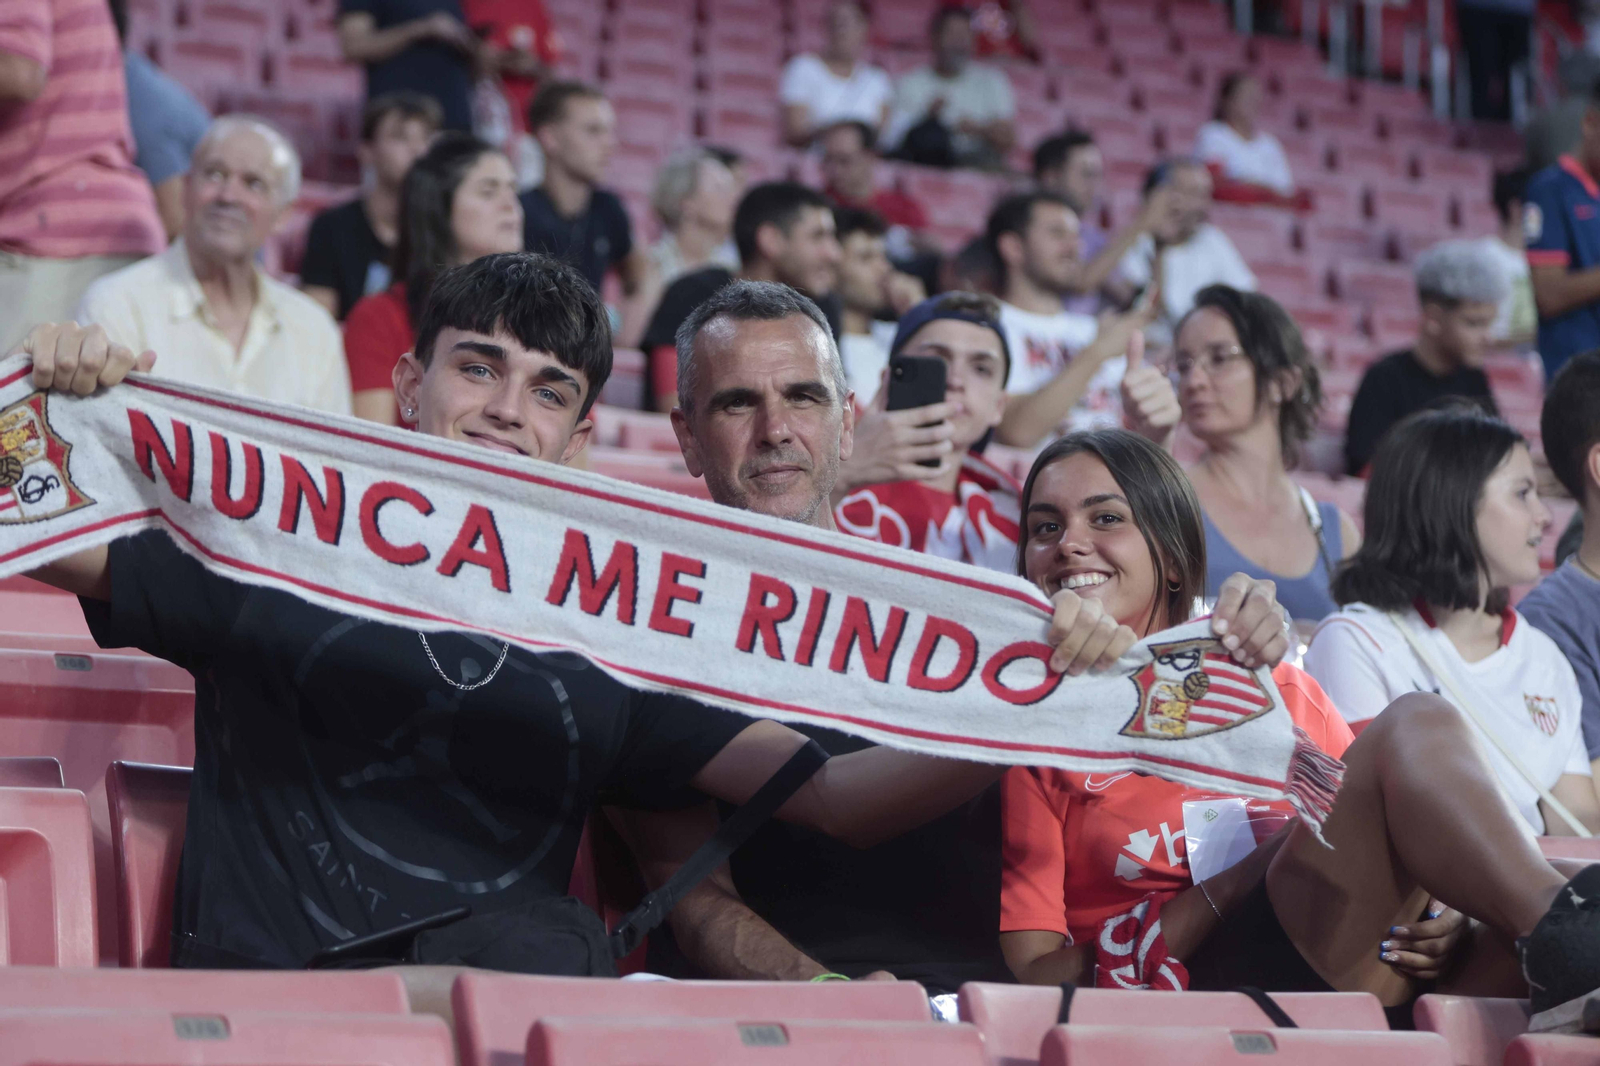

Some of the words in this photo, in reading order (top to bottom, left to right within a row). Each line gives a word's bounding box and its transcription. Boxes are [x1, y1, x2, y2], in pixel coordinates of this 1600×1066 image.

[127, 408, 511, 593] NUNCA
[544, 527, 707, 638] ME
[735, 572, 1064, 706] RINDO
